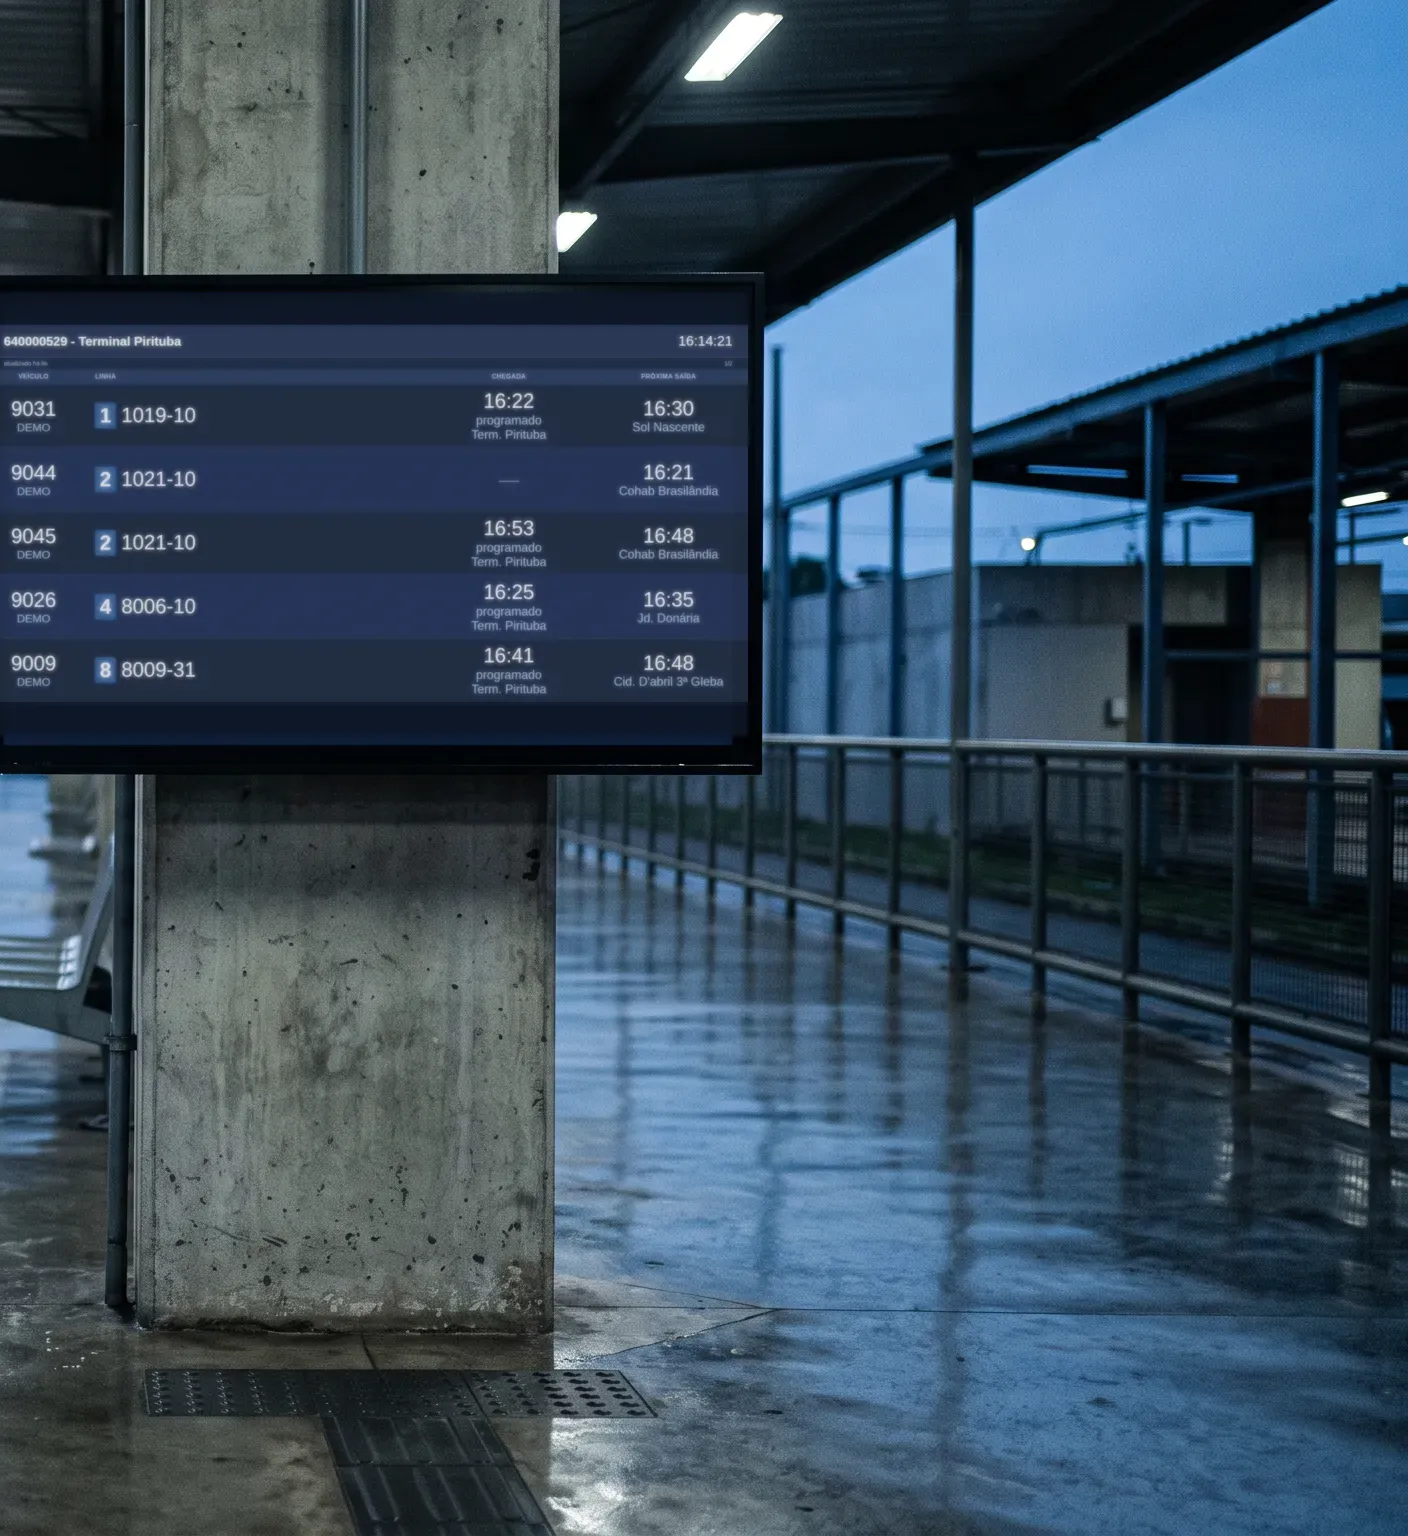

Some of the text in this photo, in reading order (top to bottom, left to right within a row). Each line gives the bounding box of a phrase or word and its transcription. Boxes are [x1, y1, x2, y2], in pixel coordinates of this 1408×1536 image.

[3, 336, 68, 347] 640000529
[78, 336, 131, 347] Terminal
[134, 336, 182, 347] Pirituba
[679, 335, 733, 347] 16:14:21
[18, 372, 49, 380] VEÍCULO
[641, 372, 697, 380] PRÓXIMA SAÍDA
[485, 393, 534, 409] 16:22
[12, 401, 55, 417] 9031
[644, 400, 694, 416] 16:30
[100, 407, 196, 424] 1 1019-10
[476, 415, 542, 427] programado
[17, 423, 50, 432] DEMO
[632, 421, 705, 432] Sol Nascente
[471, 429, 547, 440] Term. Pirituba
[12, 465, 56, 480] 9044
[644, 464, 693, 480] 16:21
[100, 471, 196, 487] 2 1021-10
[17, 487, 51, 496] DEMO
[619, 485, 719, 496] Cohab Brasilândia
[485, 520, 534, 536] 16:53
[11, 528, 56, 544] 9045
[644, 528, 694, 543] 16:48
[100, 534, 196, 551] 2 1021-10
[476, 542, 542, 555] programado
[17, 550, 50, 559] DEMO
[619, 548, 719, 559] Cohab Brasilândia
[471, 556, 547, 567] Term. Pirituba
[485, 584, 534, 600] 16:25
[11, 592, 56, 608] 9026
[100, 598, 196, 614] 4 8006-10
[644, 592, 694, 607] 16:35
[17, 614, 50, 623] DEMO
[476, 606, 542, 619] programado
[637, 612, 700, 624] Jd. Donária
[471, 620, 547, 631] Term. Pirituba
[485, 647, 534, 663] 16:41
[11, 655, 56, 671] 9009
[100, 661, 195, 678] 8 8009-31
[644, 655, 694, 671] 16:48
[17, 678, 50, 686] DEMO
[476, 669, 542, 682] programado
[614, 676, 724, 687] Cid. D'abril 3ª Gleba
[471, 683, 547, 694] Term. Pirituba
